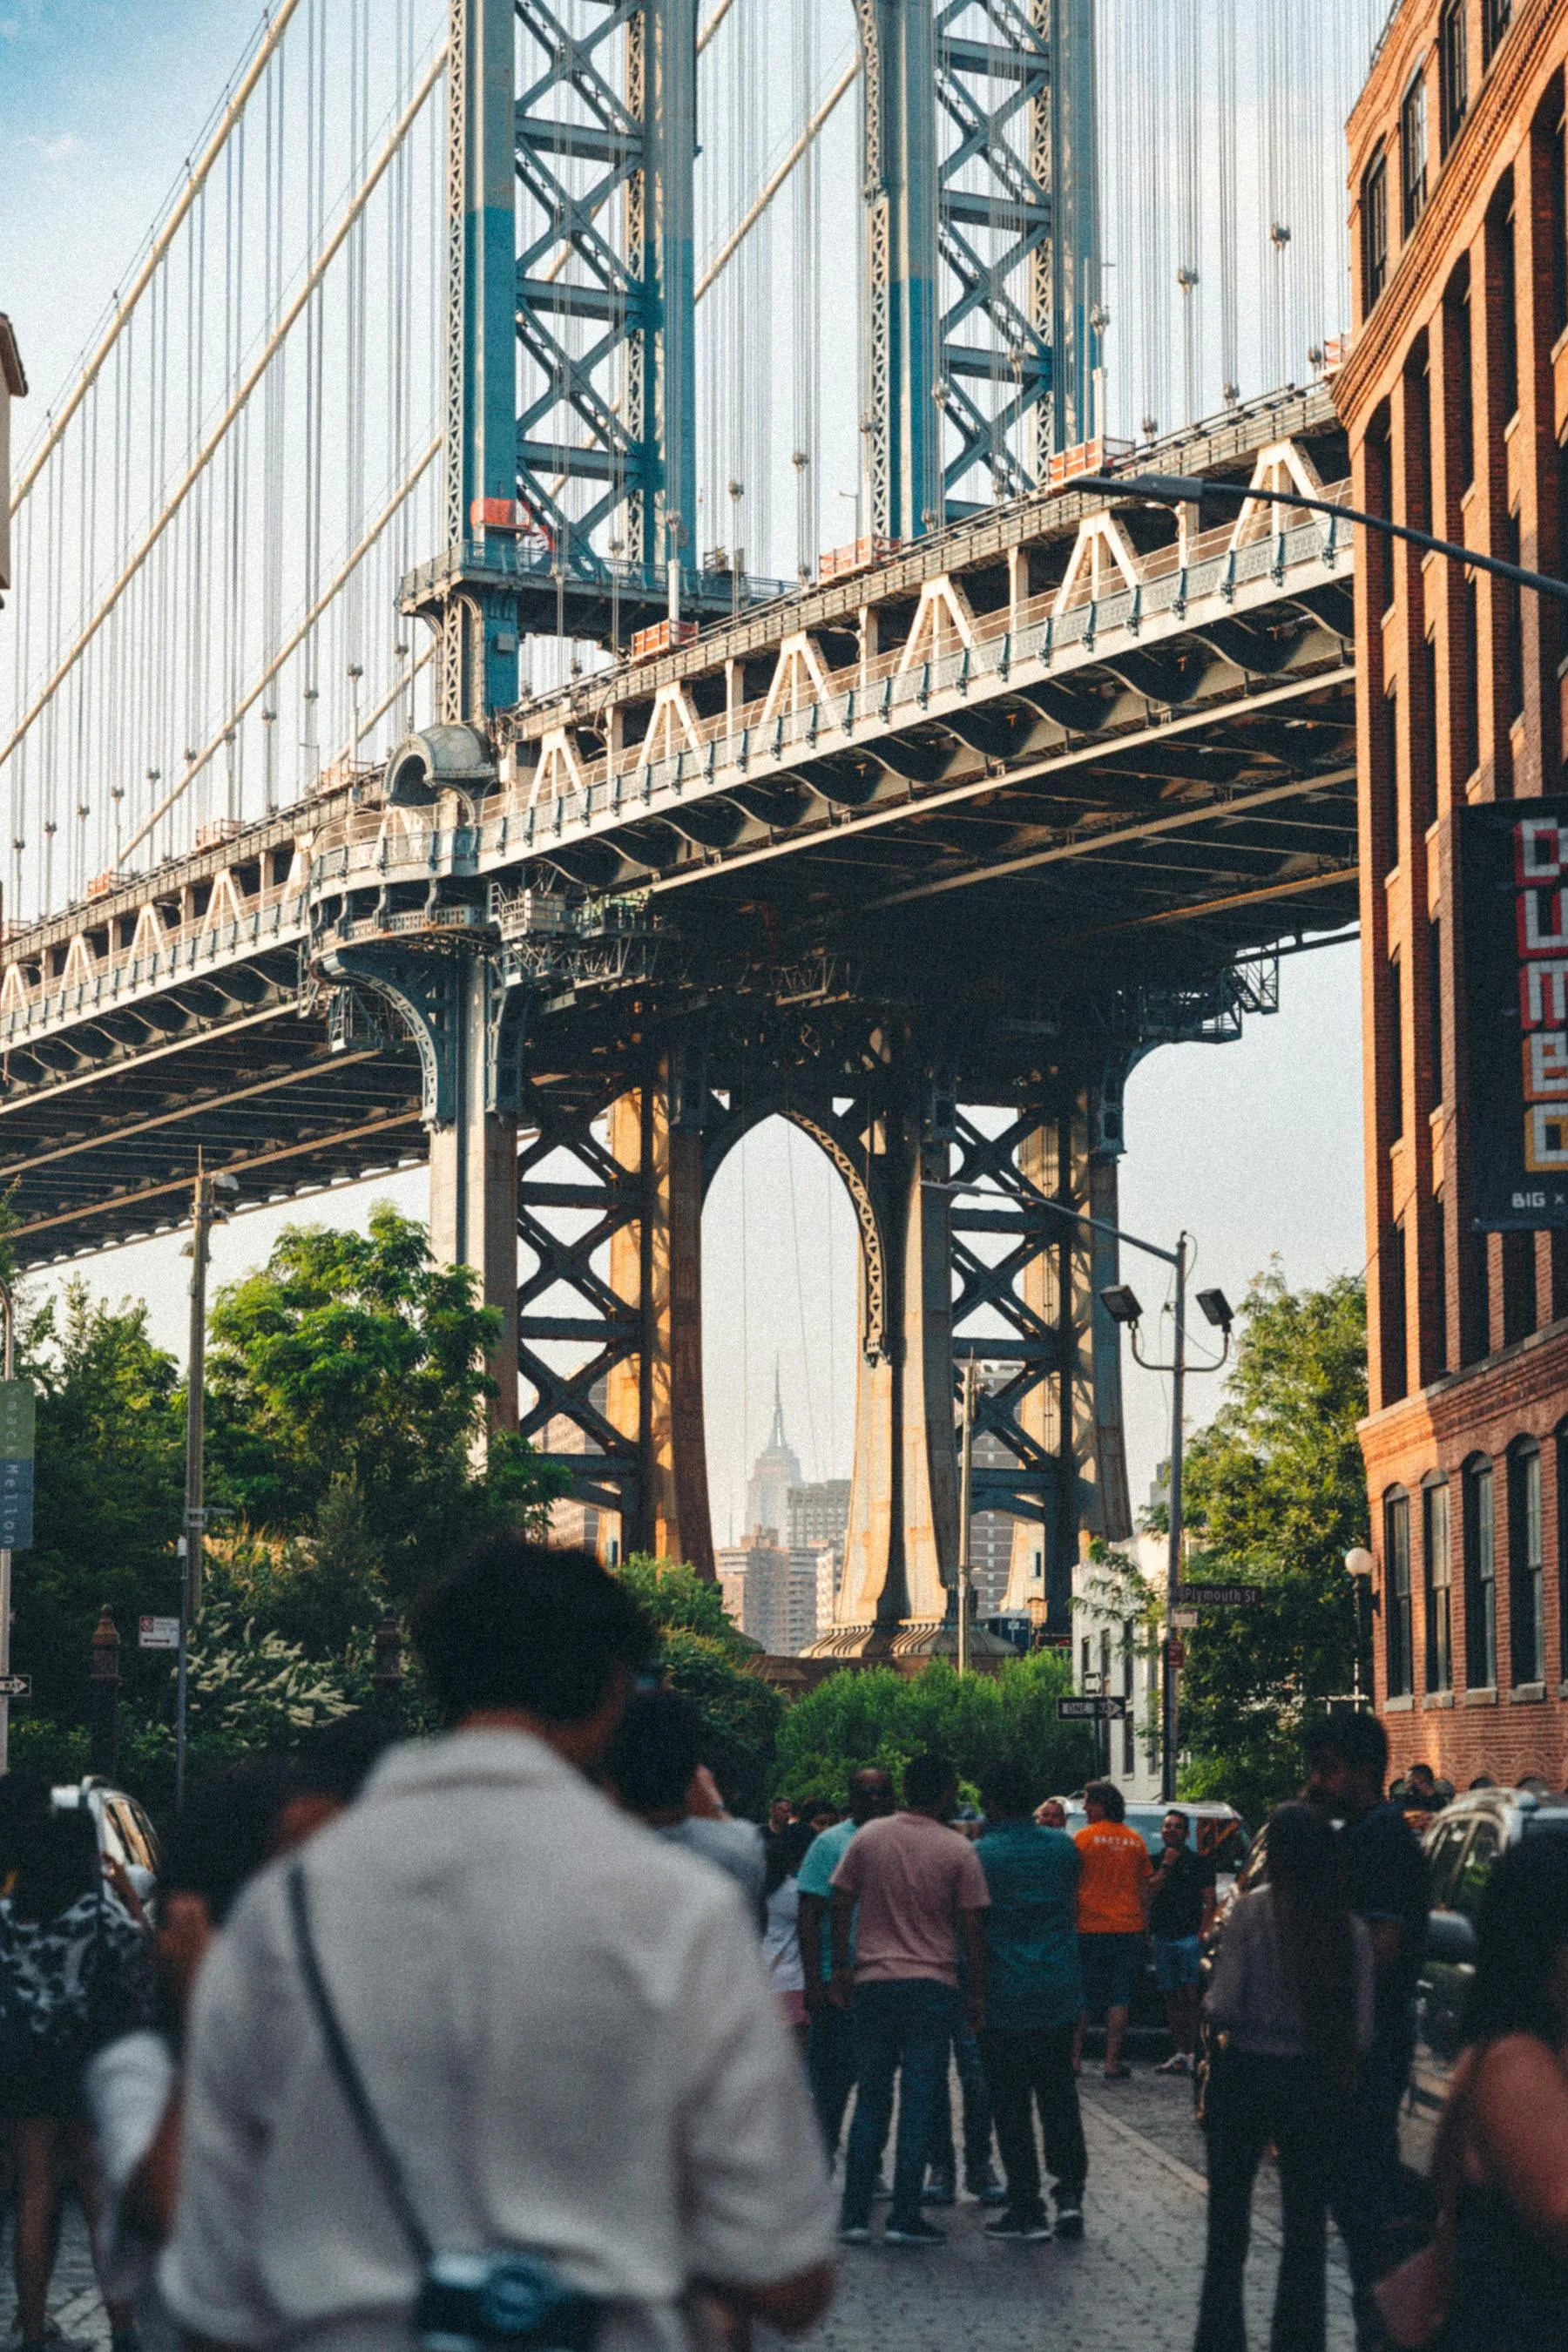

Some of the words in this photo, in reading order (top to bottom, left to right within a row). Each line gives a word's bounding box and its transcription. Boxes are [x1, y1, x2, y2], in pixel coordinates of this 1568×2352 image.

[1511, 1192, 1546, 1208] BIG
[1184, 1586, 1241, 1603] Plymouth
[1245, 1589, 1256, 1603] St
[1066, 1703, 1085, 1714] ONE
